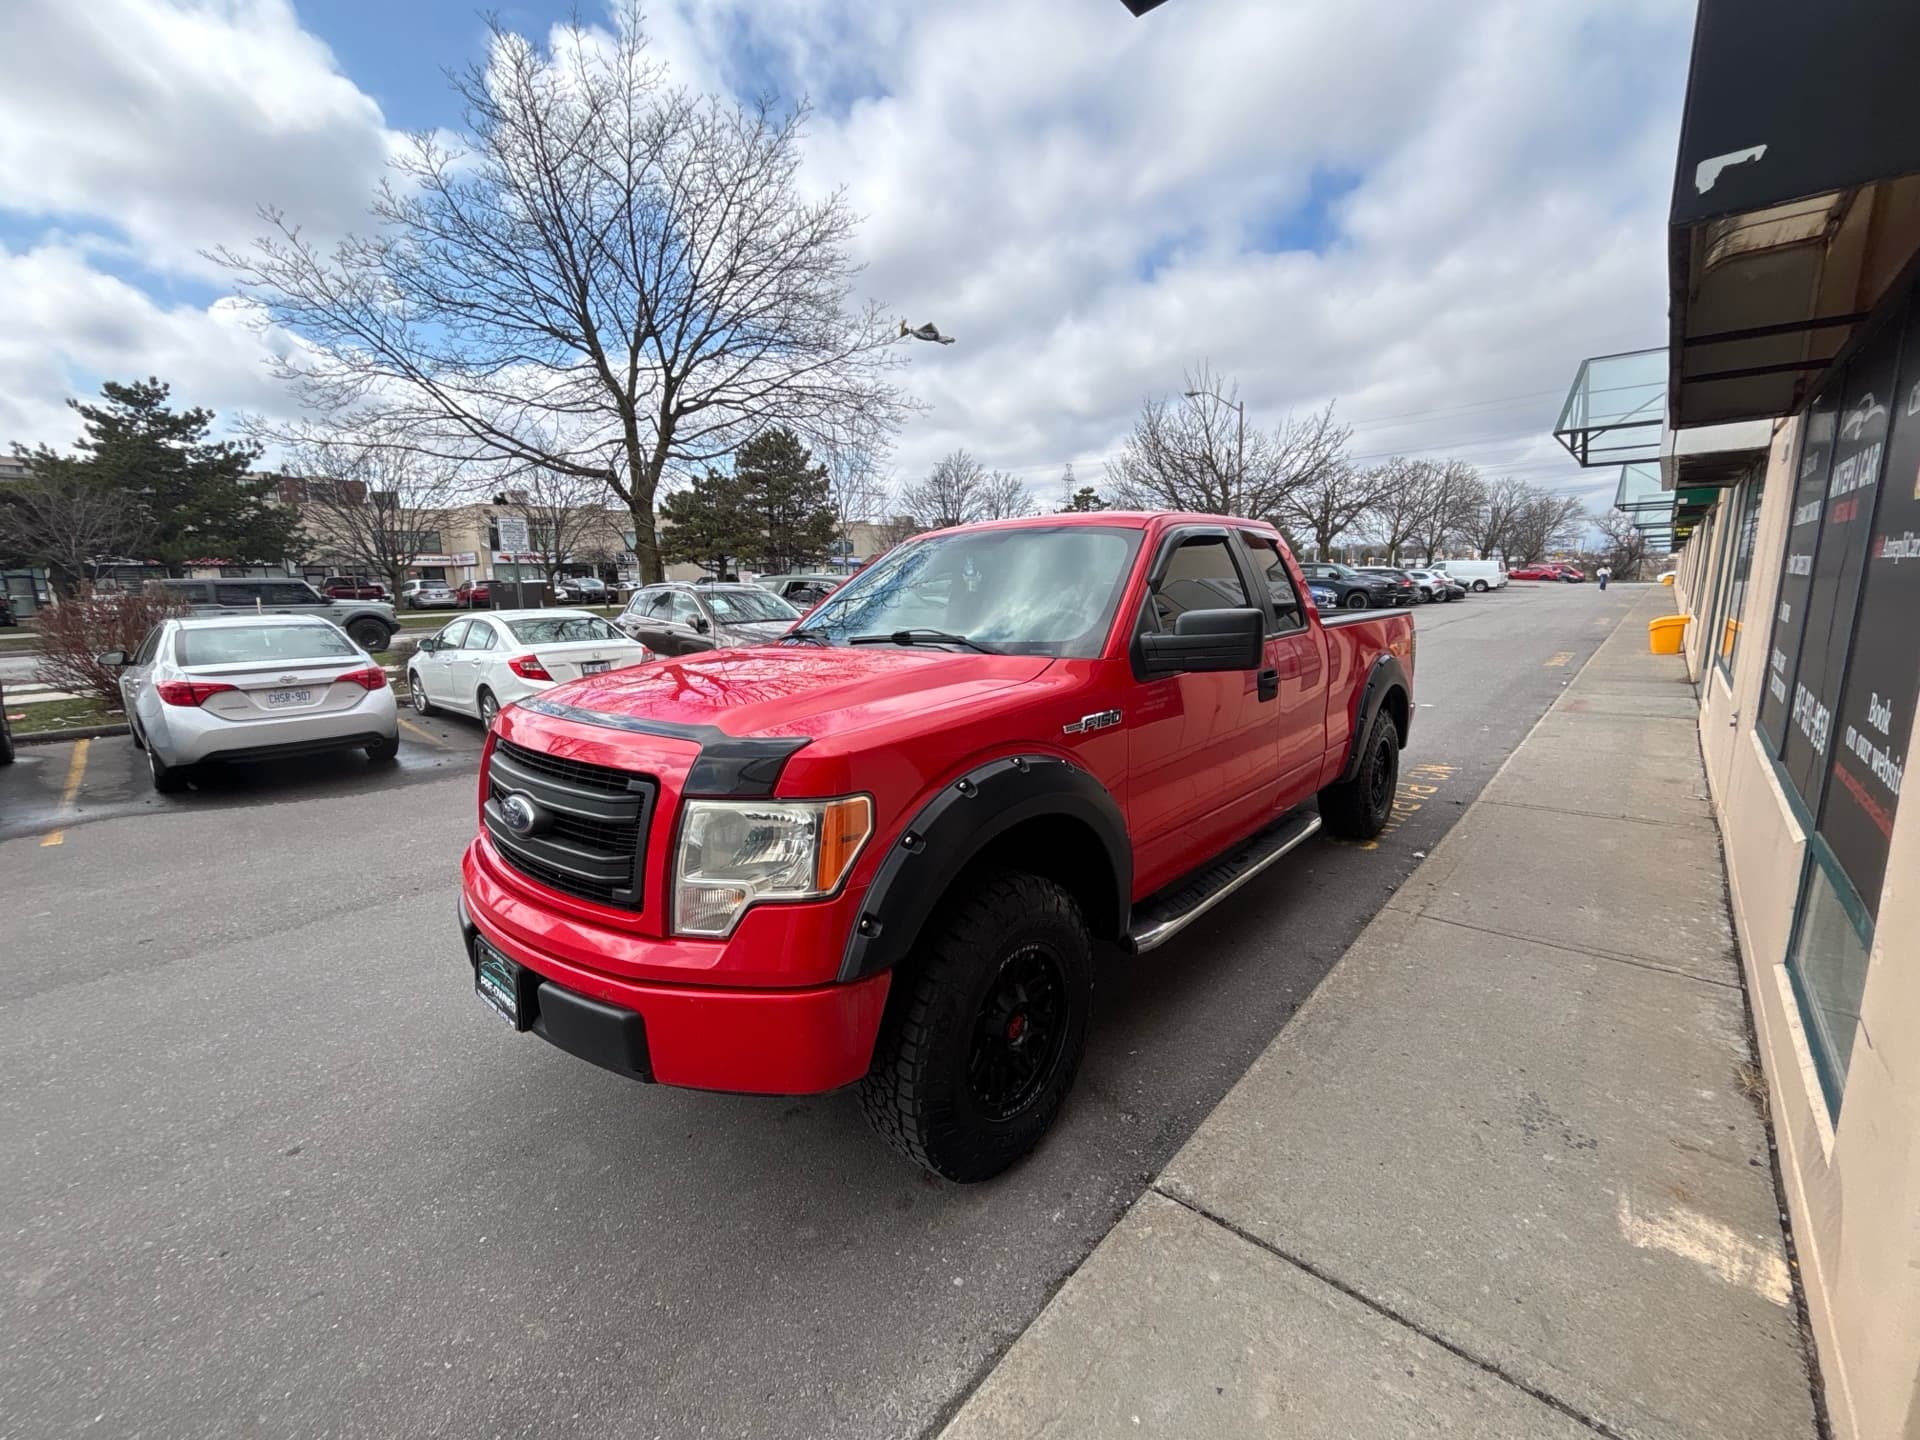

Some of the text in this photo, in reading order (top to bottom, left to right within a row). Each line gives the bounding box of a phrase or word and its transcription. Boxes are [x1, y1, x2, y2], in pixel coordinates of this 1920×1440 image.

[1868, 692, 1892, 735] Book
[1846, 725, 1903, 795] on our websit
